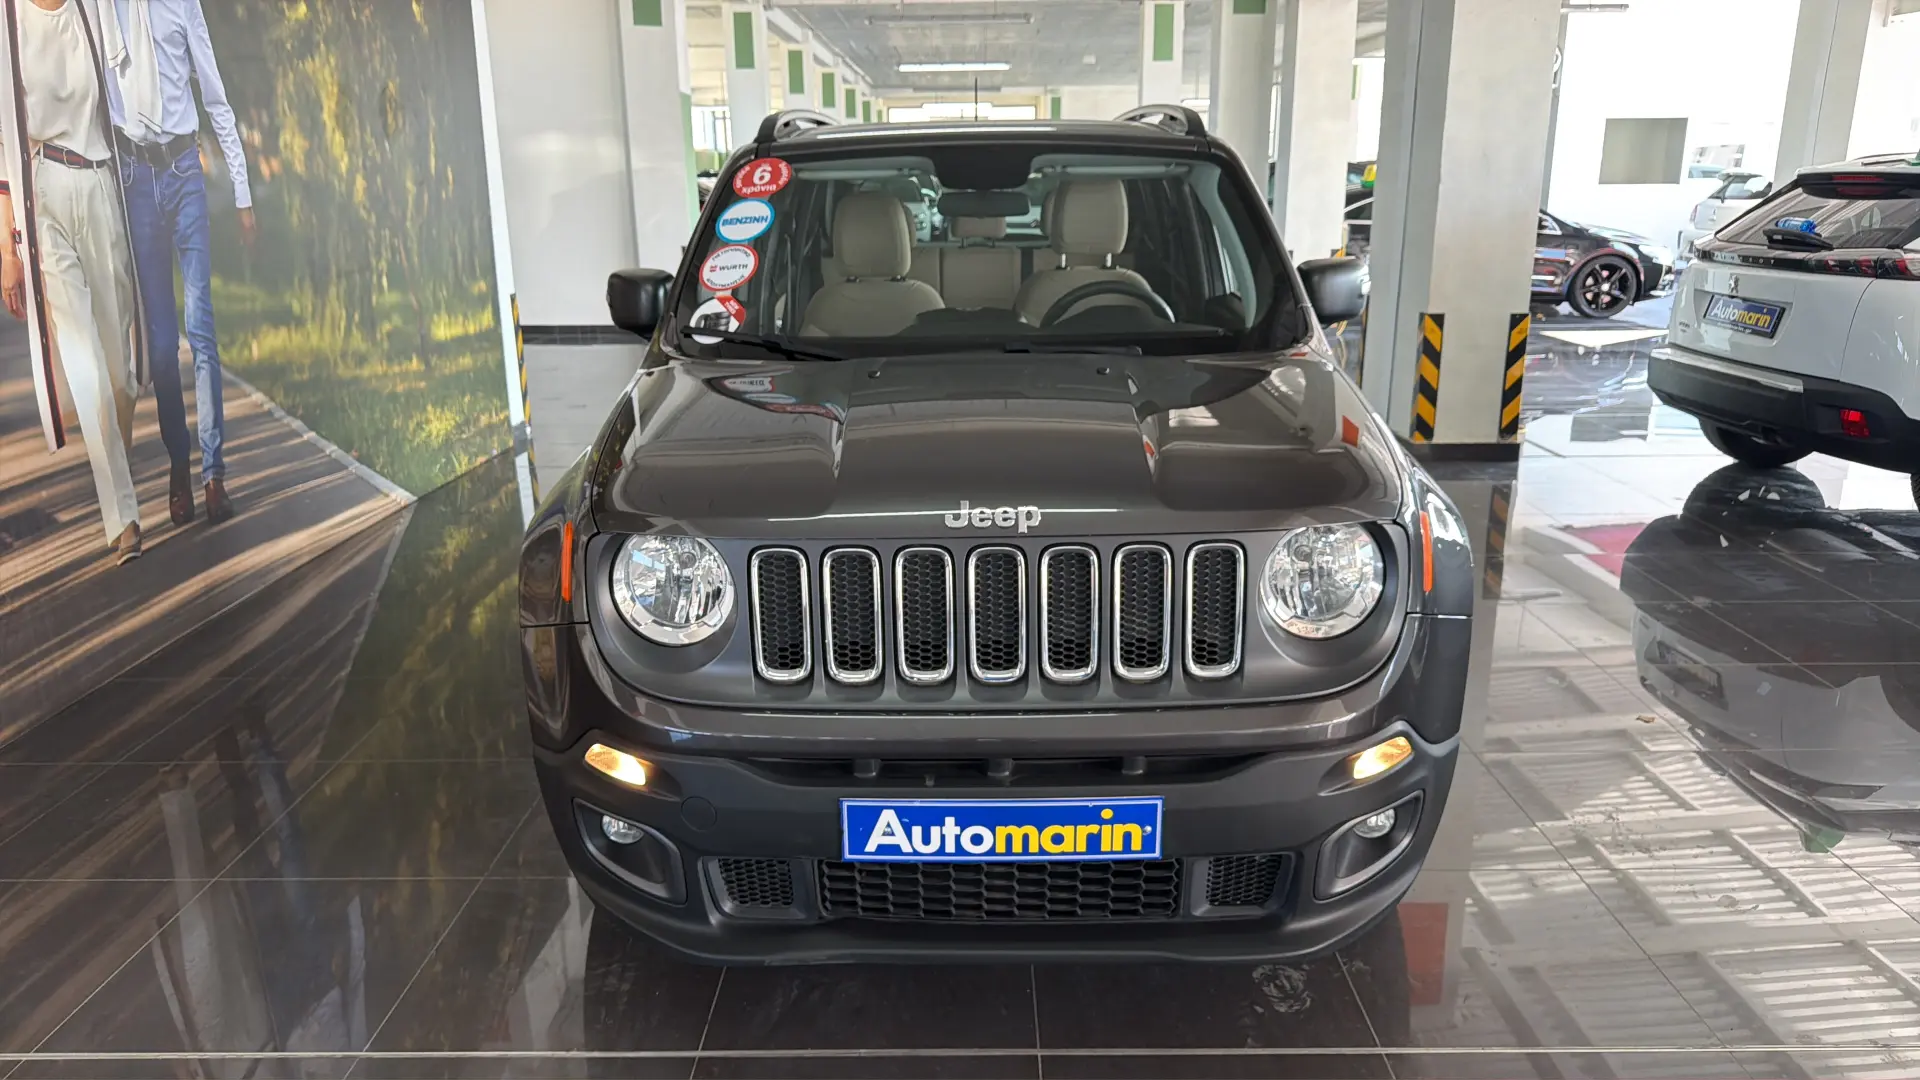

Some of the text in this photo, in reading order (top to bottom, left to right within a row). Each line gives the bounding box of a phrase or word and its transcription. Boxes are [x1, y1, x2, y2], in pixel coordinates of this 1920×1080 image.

[753, 164, 773, 185] 6
[1711, 299, 1771, 328] Automarin
[944, 500, 1042, 533] Jeep
[864, 808, 1143, 854] Automarin
